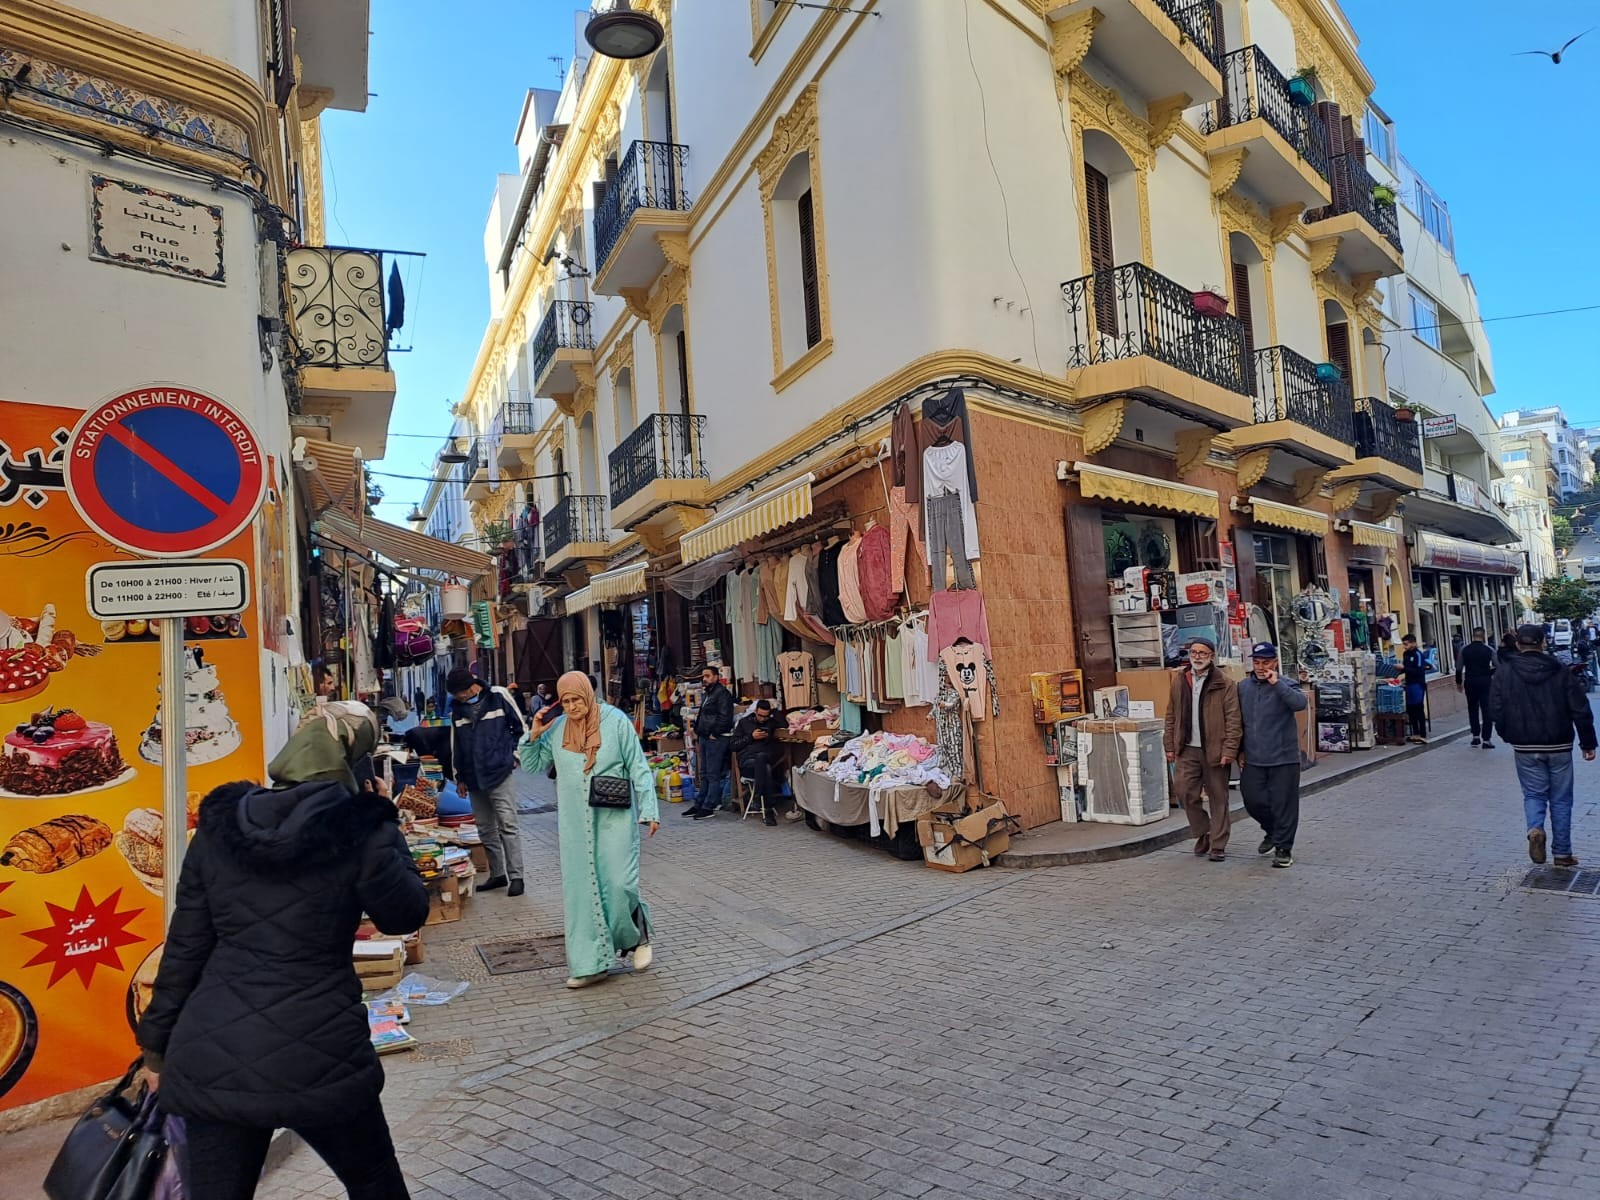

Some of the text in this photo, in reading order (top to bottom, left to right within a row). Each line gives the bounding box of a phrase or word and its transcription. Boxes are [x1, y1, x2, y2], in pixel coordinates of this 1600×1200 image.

[138, 200, 182, 217] زنقة
[140, 231, 180, 246] Rue
[132, 244, 190, 262] d'Italie
[76, 391, 258, 465] STATIONNEMENT INTERDIT
[116, 579, 144, 588] 10H00
[146, 578, 152, 587] à
[154, 578, 182, 586] 21H00
[189, 577, 212, 585] Hiver
[101, 595, 113, 603] De
[117, 594, 144, 602] 11H00
[146, 593, 152, 601] à
[154, 592, 182, 600] 22H00
[66, 914, 96, 935] خبز
[63, 936, 108, 957] المقلة
